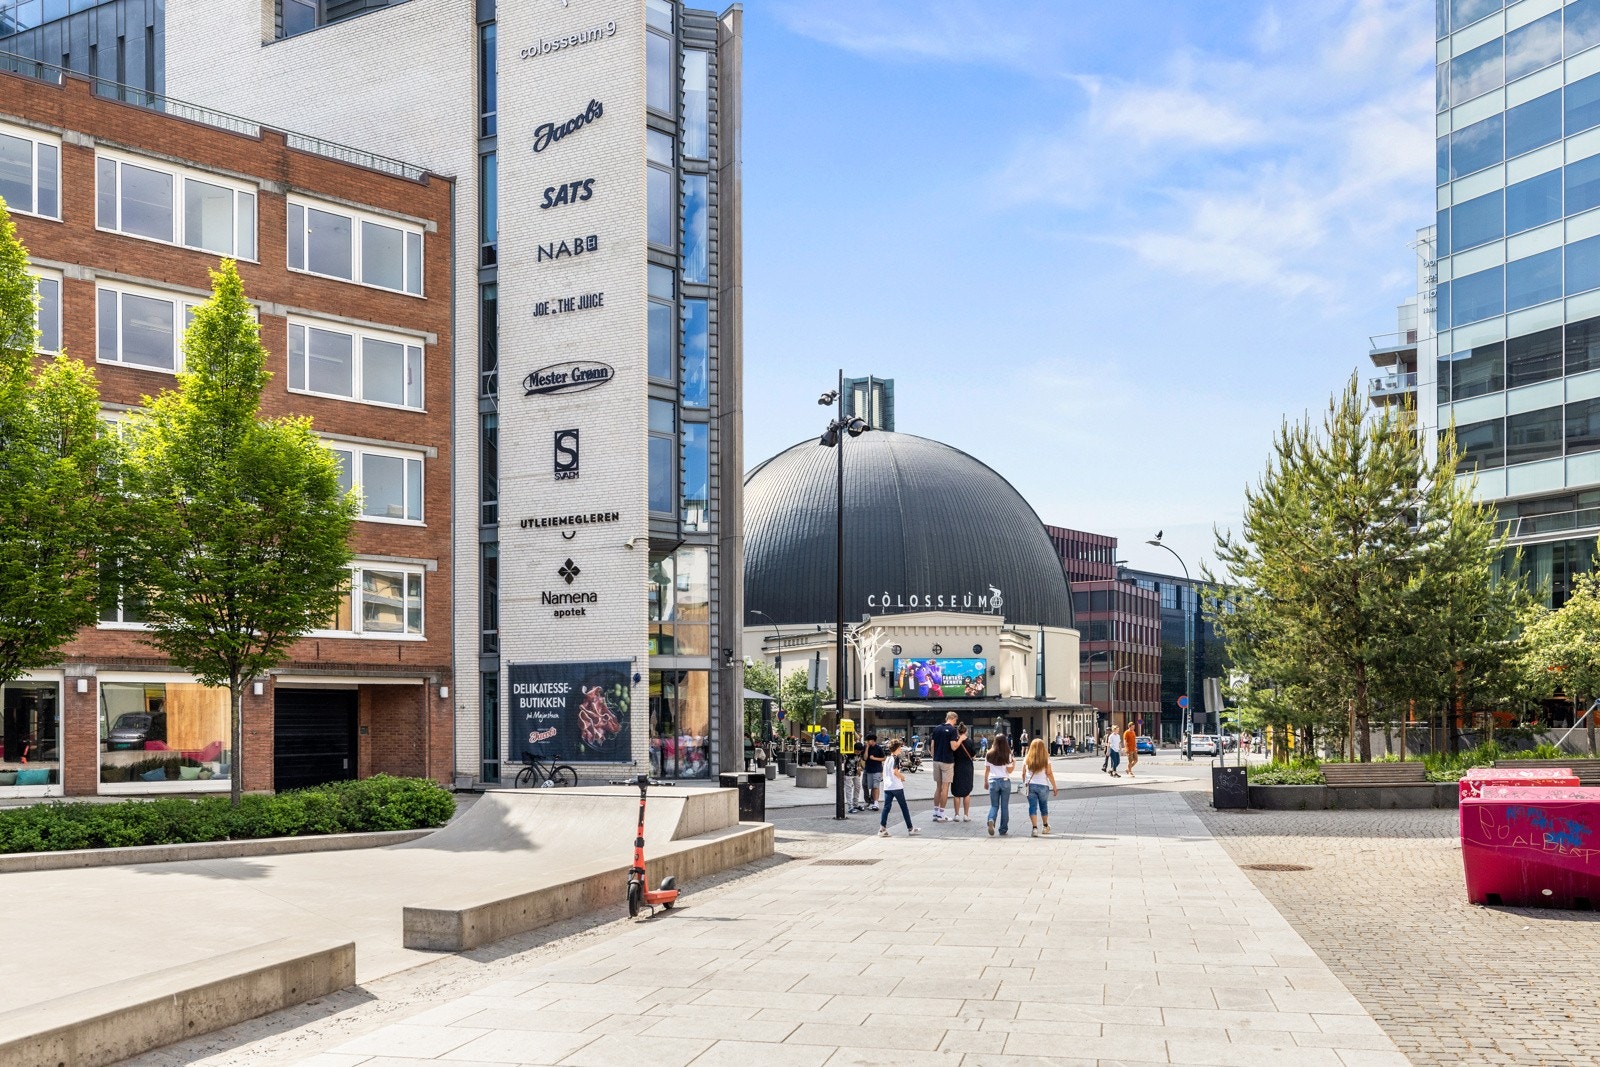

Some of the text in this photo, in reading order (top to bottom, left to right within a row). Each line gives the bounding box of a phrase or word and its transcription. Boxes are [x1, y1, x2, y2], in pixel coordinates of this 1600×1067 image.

[519, 20, 617, 59] colosseum 9
[533, 98, 604, 153] Jacob's
[540, 178, 596, 210] SATS
[533, 301, 550, 317] JOE
[558, 297, 575, 313] THE
[577, 292, 604, 310] JUICE
[529, 367, 609, 388] Mester Grønn
[520, 512, 620, 529] UTLEIEMEGLEREN
[541, 590, 598, 605] Namena
[554, 607, 586, 618] apotek
[513, 682, 572, 695] DELIKATESSE-
[520, 697, 566, 708] BUTIKKEN
